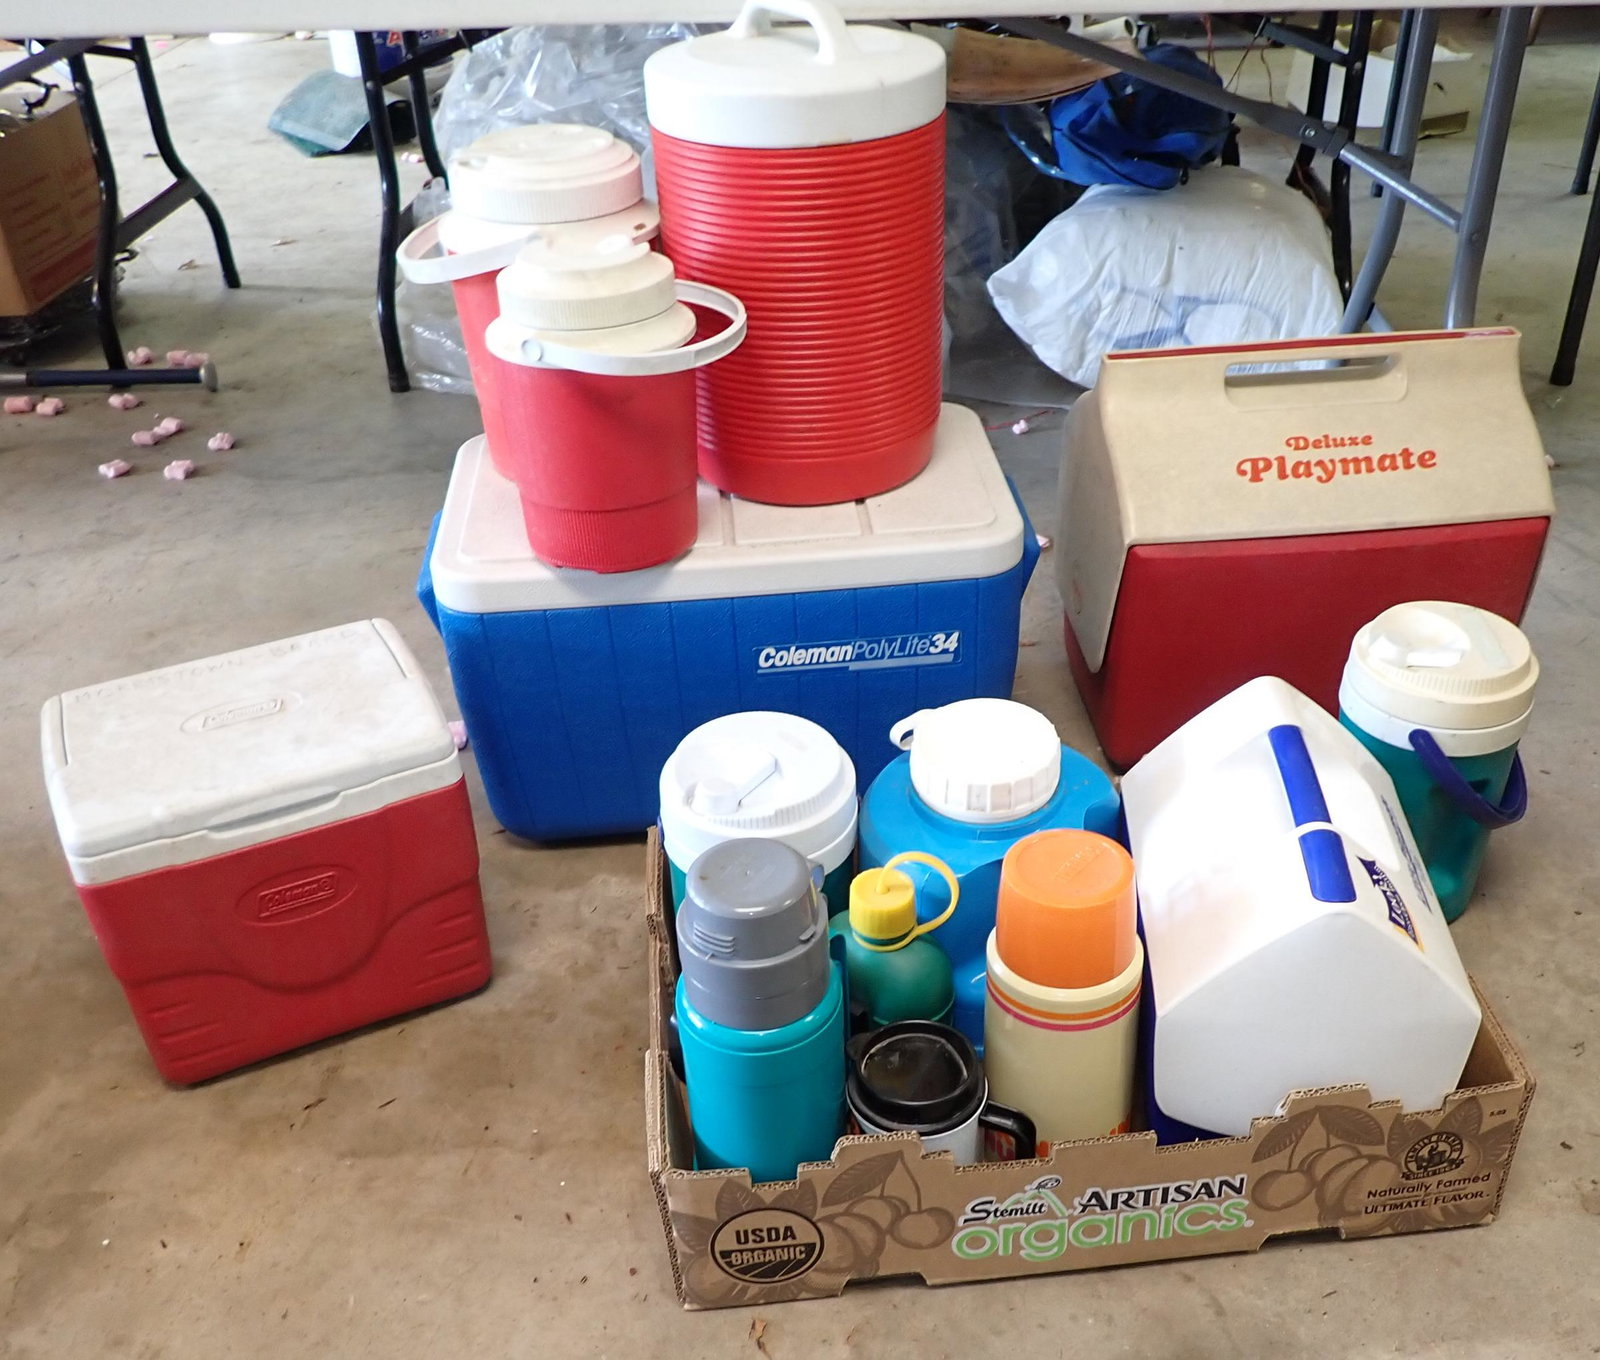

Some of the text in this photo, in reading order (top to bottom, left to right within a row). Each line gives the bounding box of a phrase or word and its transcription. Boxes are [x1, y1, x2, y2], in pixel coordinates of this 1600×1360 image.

[1285, 434, 1373, 451] Deluxe
[1236, 447, 1438, 484] Playmate
[1078, 1176, 1246, 1214] ARTISAN
[1367, 1182, 1432, 1199] Naturally
[1436, 1172, 1491, 1189] Farmed
[961, 1199, 1047, 1225] Stemilt
[1364, 1199, 1428, 1215] ULTIMATE
[1433, 1191, 1484, 1206] FLAVOR
[735, 1225, 798, 1245] USDA
[953, 1199, 1248, 1261] organics
[731, 1246, 806, 1266] ORGANIC
